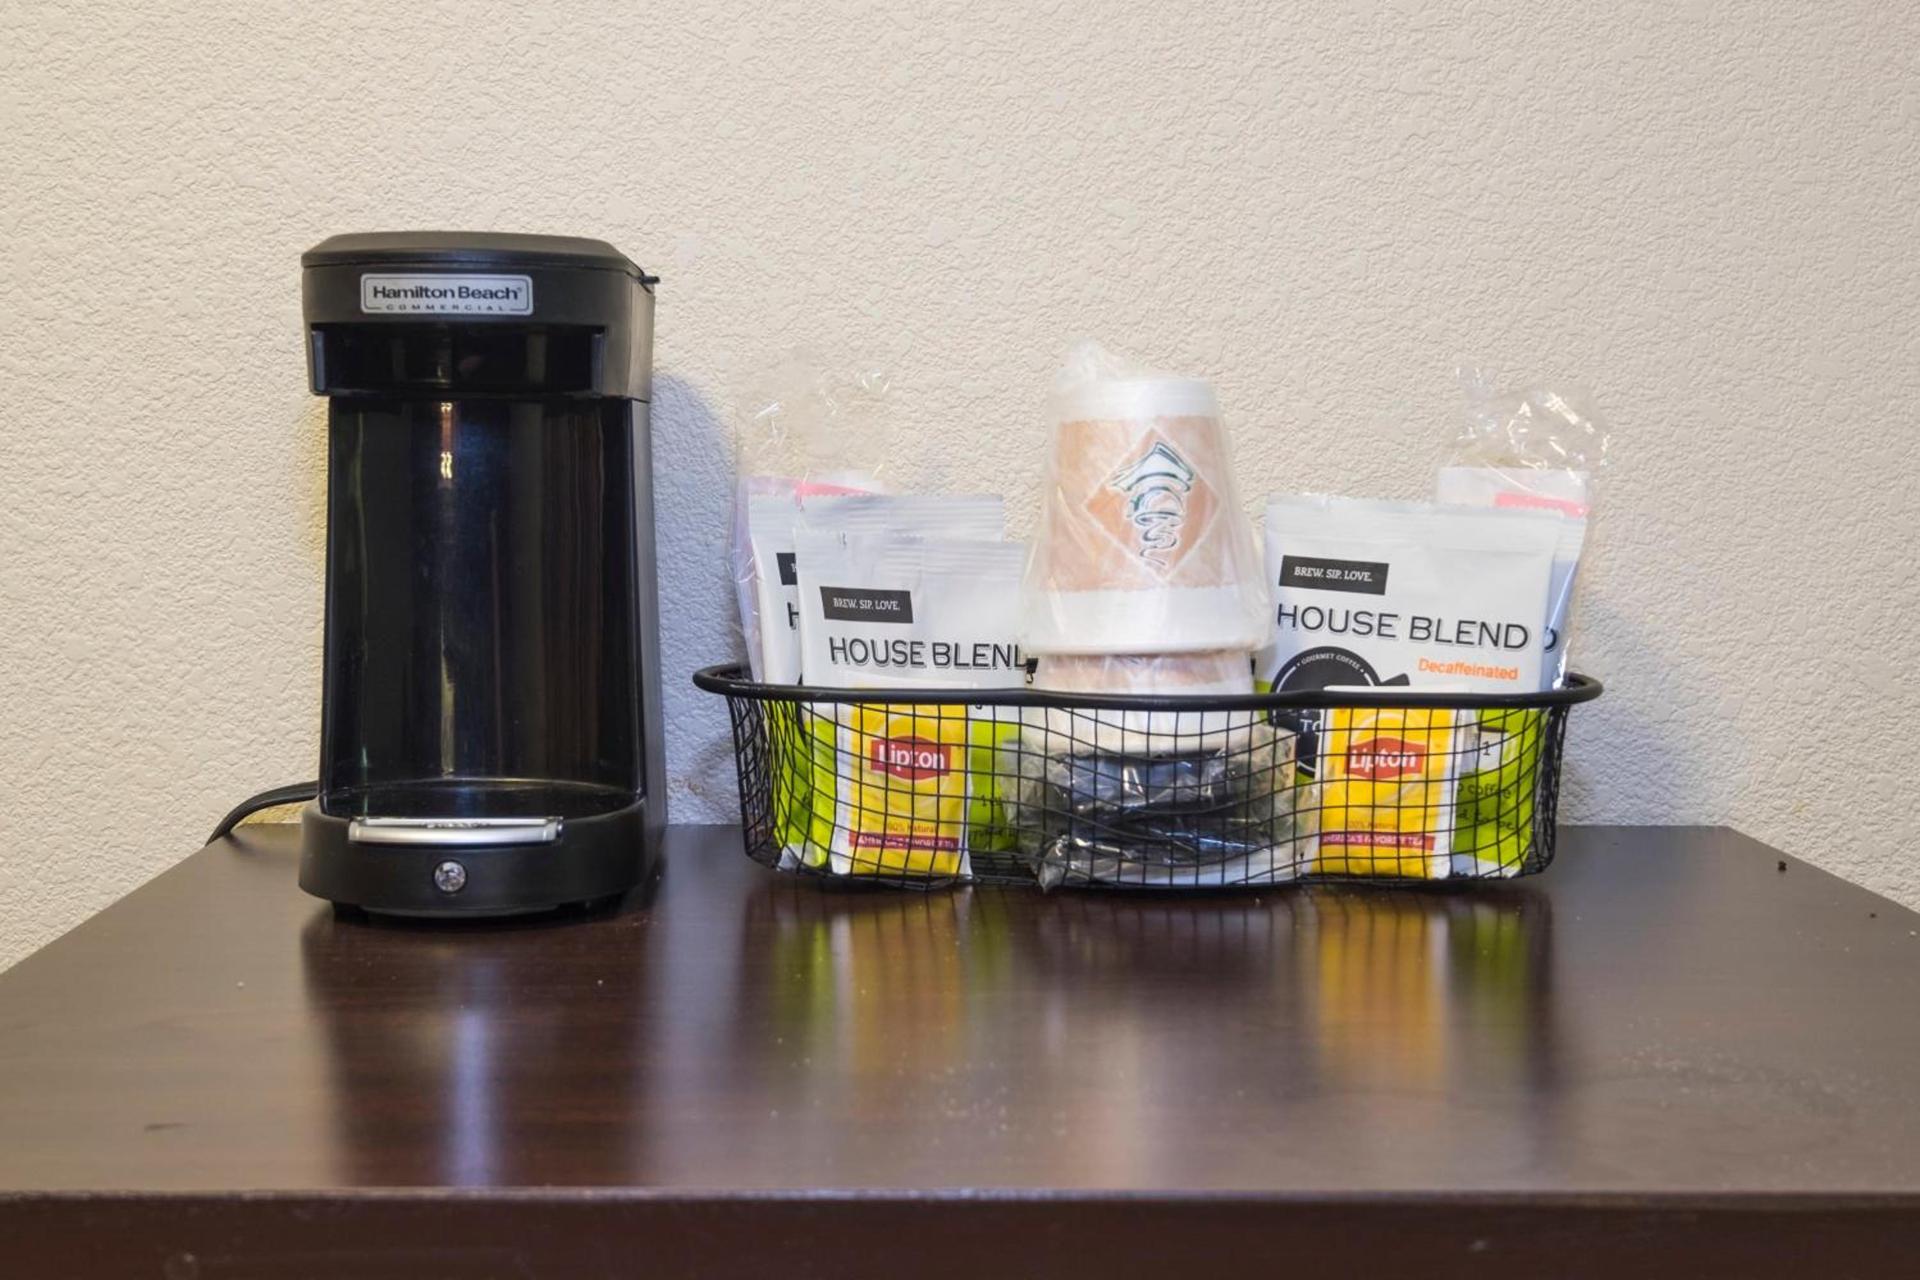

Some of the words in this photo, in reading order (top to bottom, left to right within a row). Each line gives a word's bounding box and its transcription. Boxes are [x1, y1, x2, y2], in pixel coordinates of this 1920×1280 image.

[373, 285, 455, 299] Hamilton
[386, 304, 504, 312] COMMERCIAL
[1294, 566, 1324, 578] BREW.
[1326, 568, 1343, 580] SIP.
[1344, 570, 1373, 582] LOVE.
[833, 597, 858, 609] BREW.
[860, 599, 874, 610] SIP.
[875, 600, 901, 612] LOVE.
[1277, 602, 1399, 639] HOUSE
[1408, 615, 1529, 650] BLEND
[829, 636, 927, 668] HOUSE
[1301, 653, 1336, 665] GOURMET
[1335, 654, 1361, 671] COFFEE
[1418, 657, 1519, 681] Decaffeinated
[1349, 747, 1417, 773] Lipton
